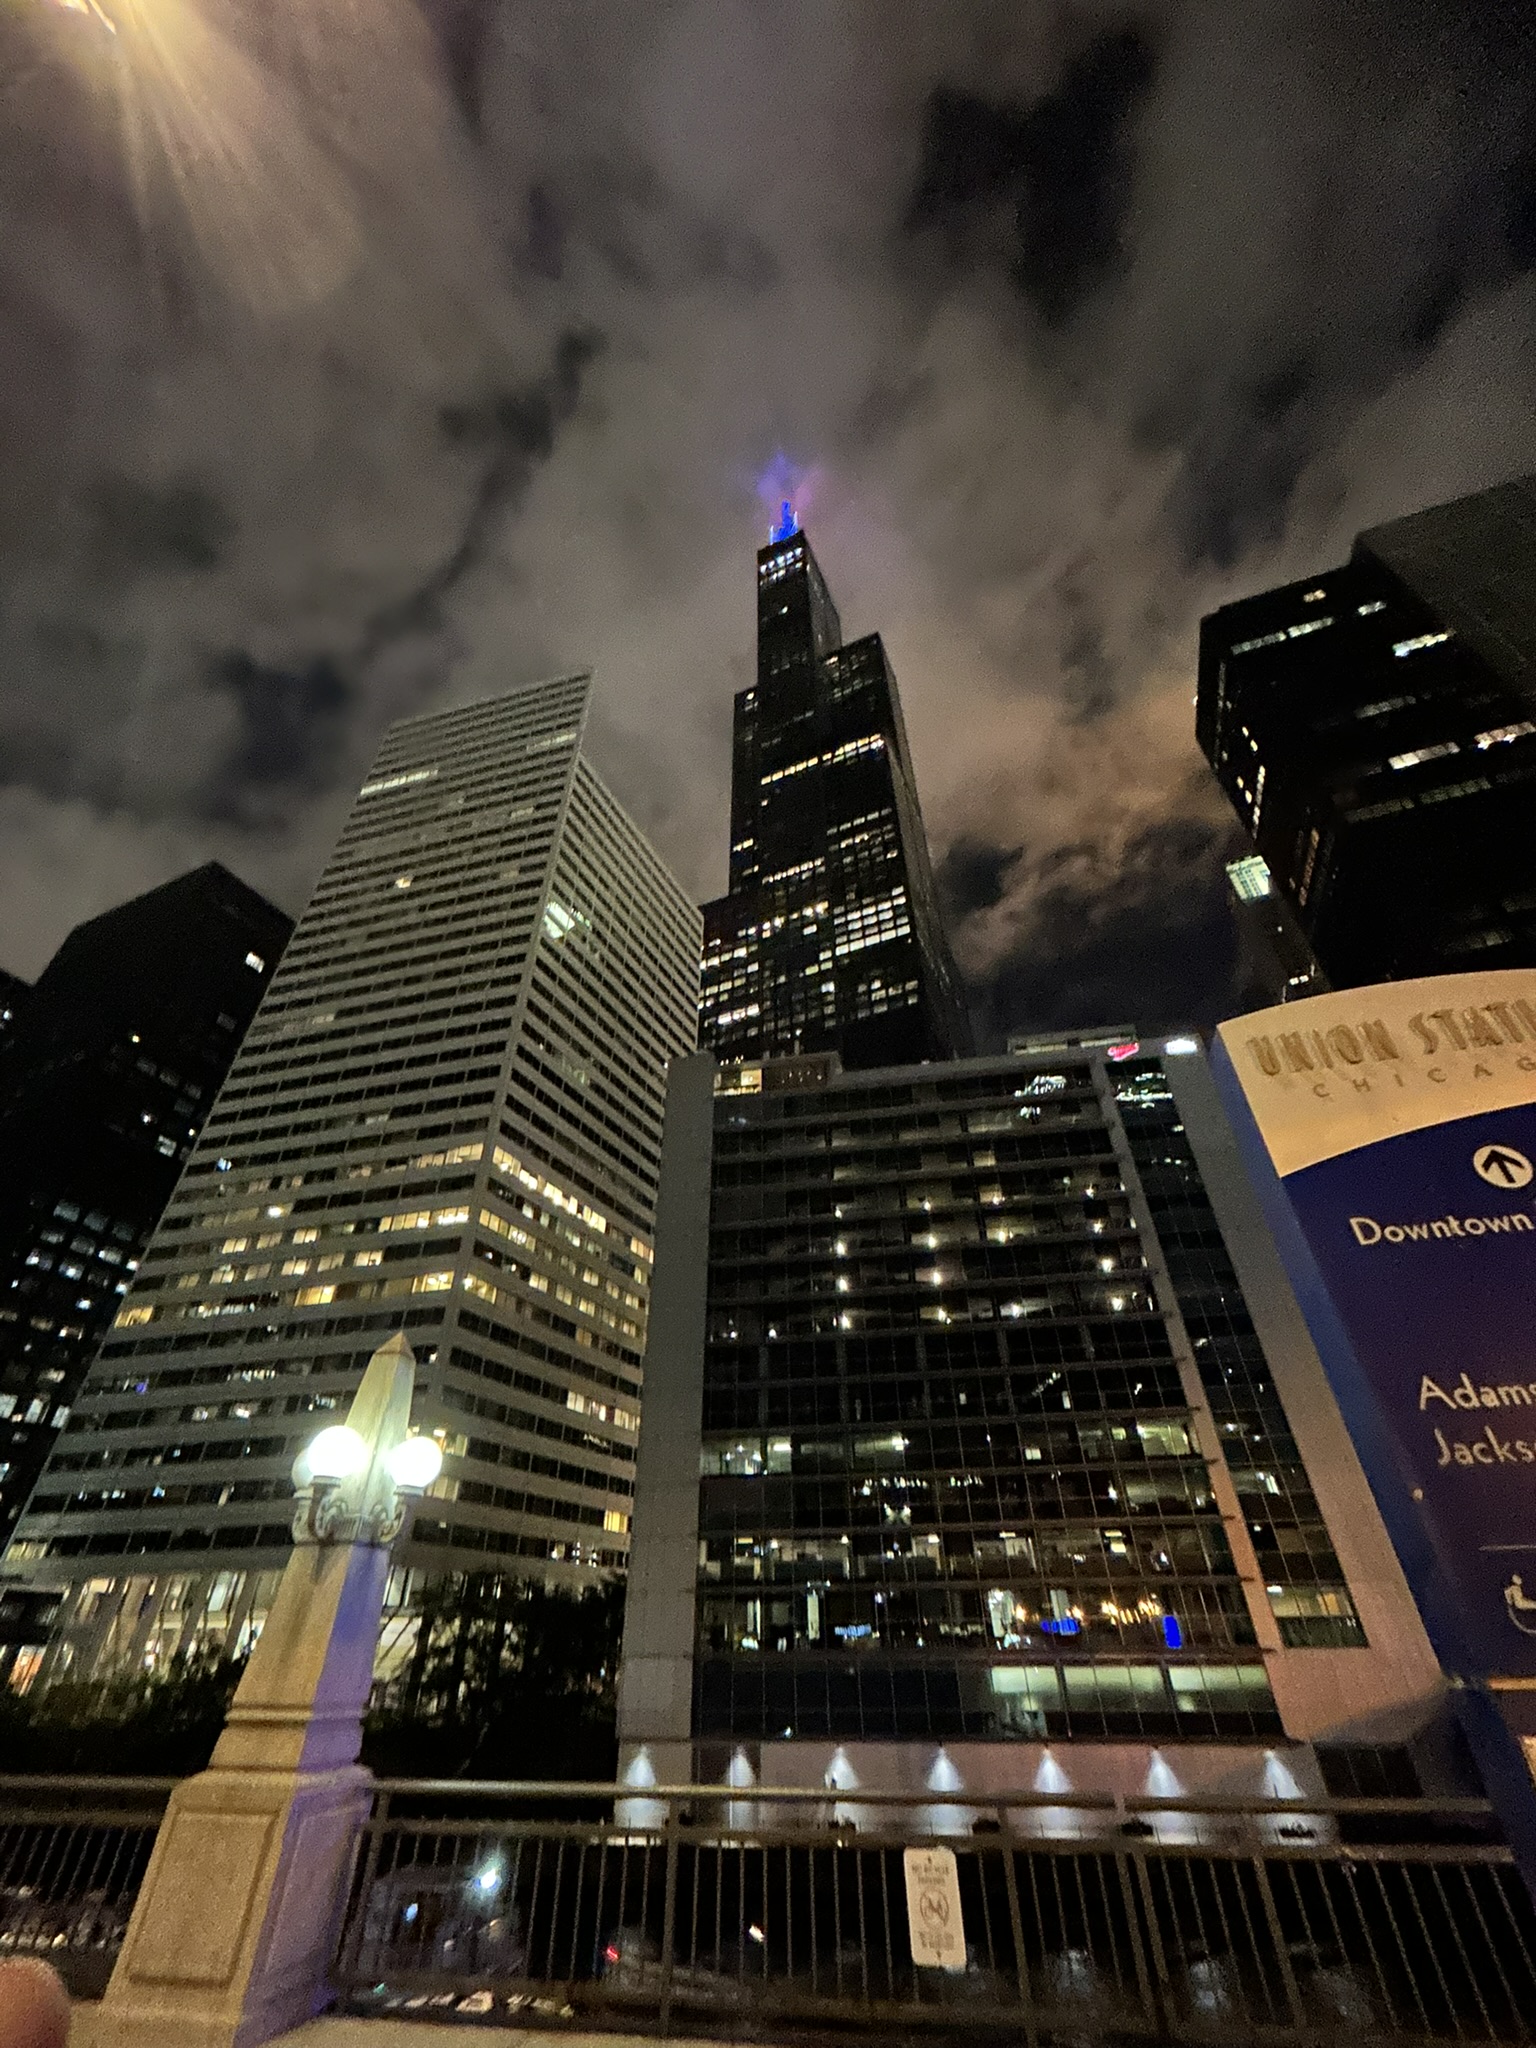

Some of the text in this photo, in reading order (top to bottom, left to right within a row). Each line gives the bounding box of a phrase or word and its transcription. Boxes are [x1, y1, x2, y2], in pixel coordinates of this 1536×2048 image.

[1246, 1018, 1400, 1076] UNION
[1350, 1212, 1535, 1246] Downtown
[1434, 1424, 1536, 1468] Jacks
